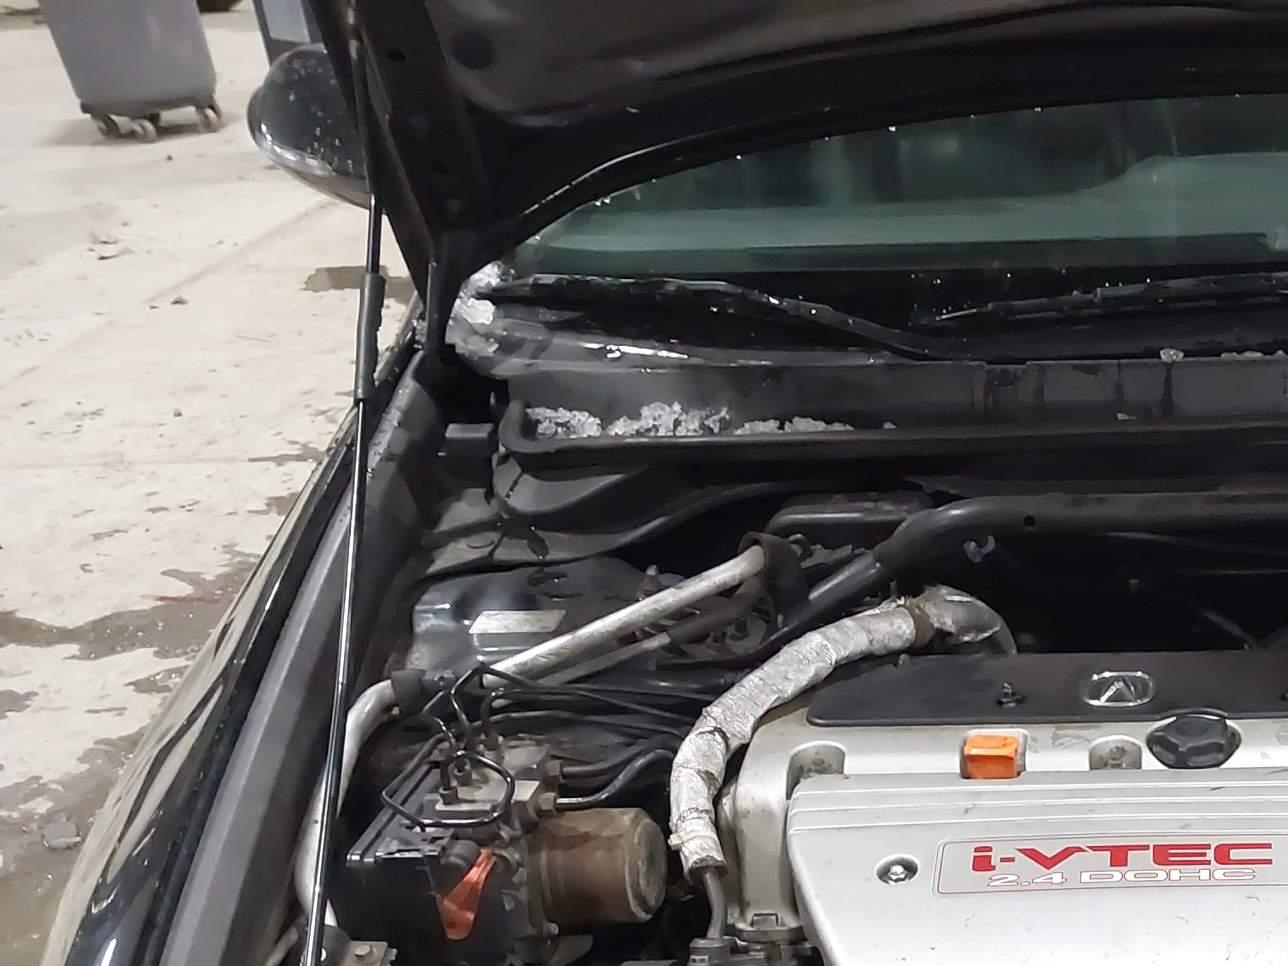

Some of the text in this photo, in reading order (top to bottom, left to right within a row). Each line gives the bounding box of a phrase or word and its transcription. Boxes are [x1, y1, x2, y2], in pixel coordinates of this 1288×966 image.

[971, 843, 1273, 872] i-VTEC
[987, 868, 1257, 887] 2.4 DOHC
